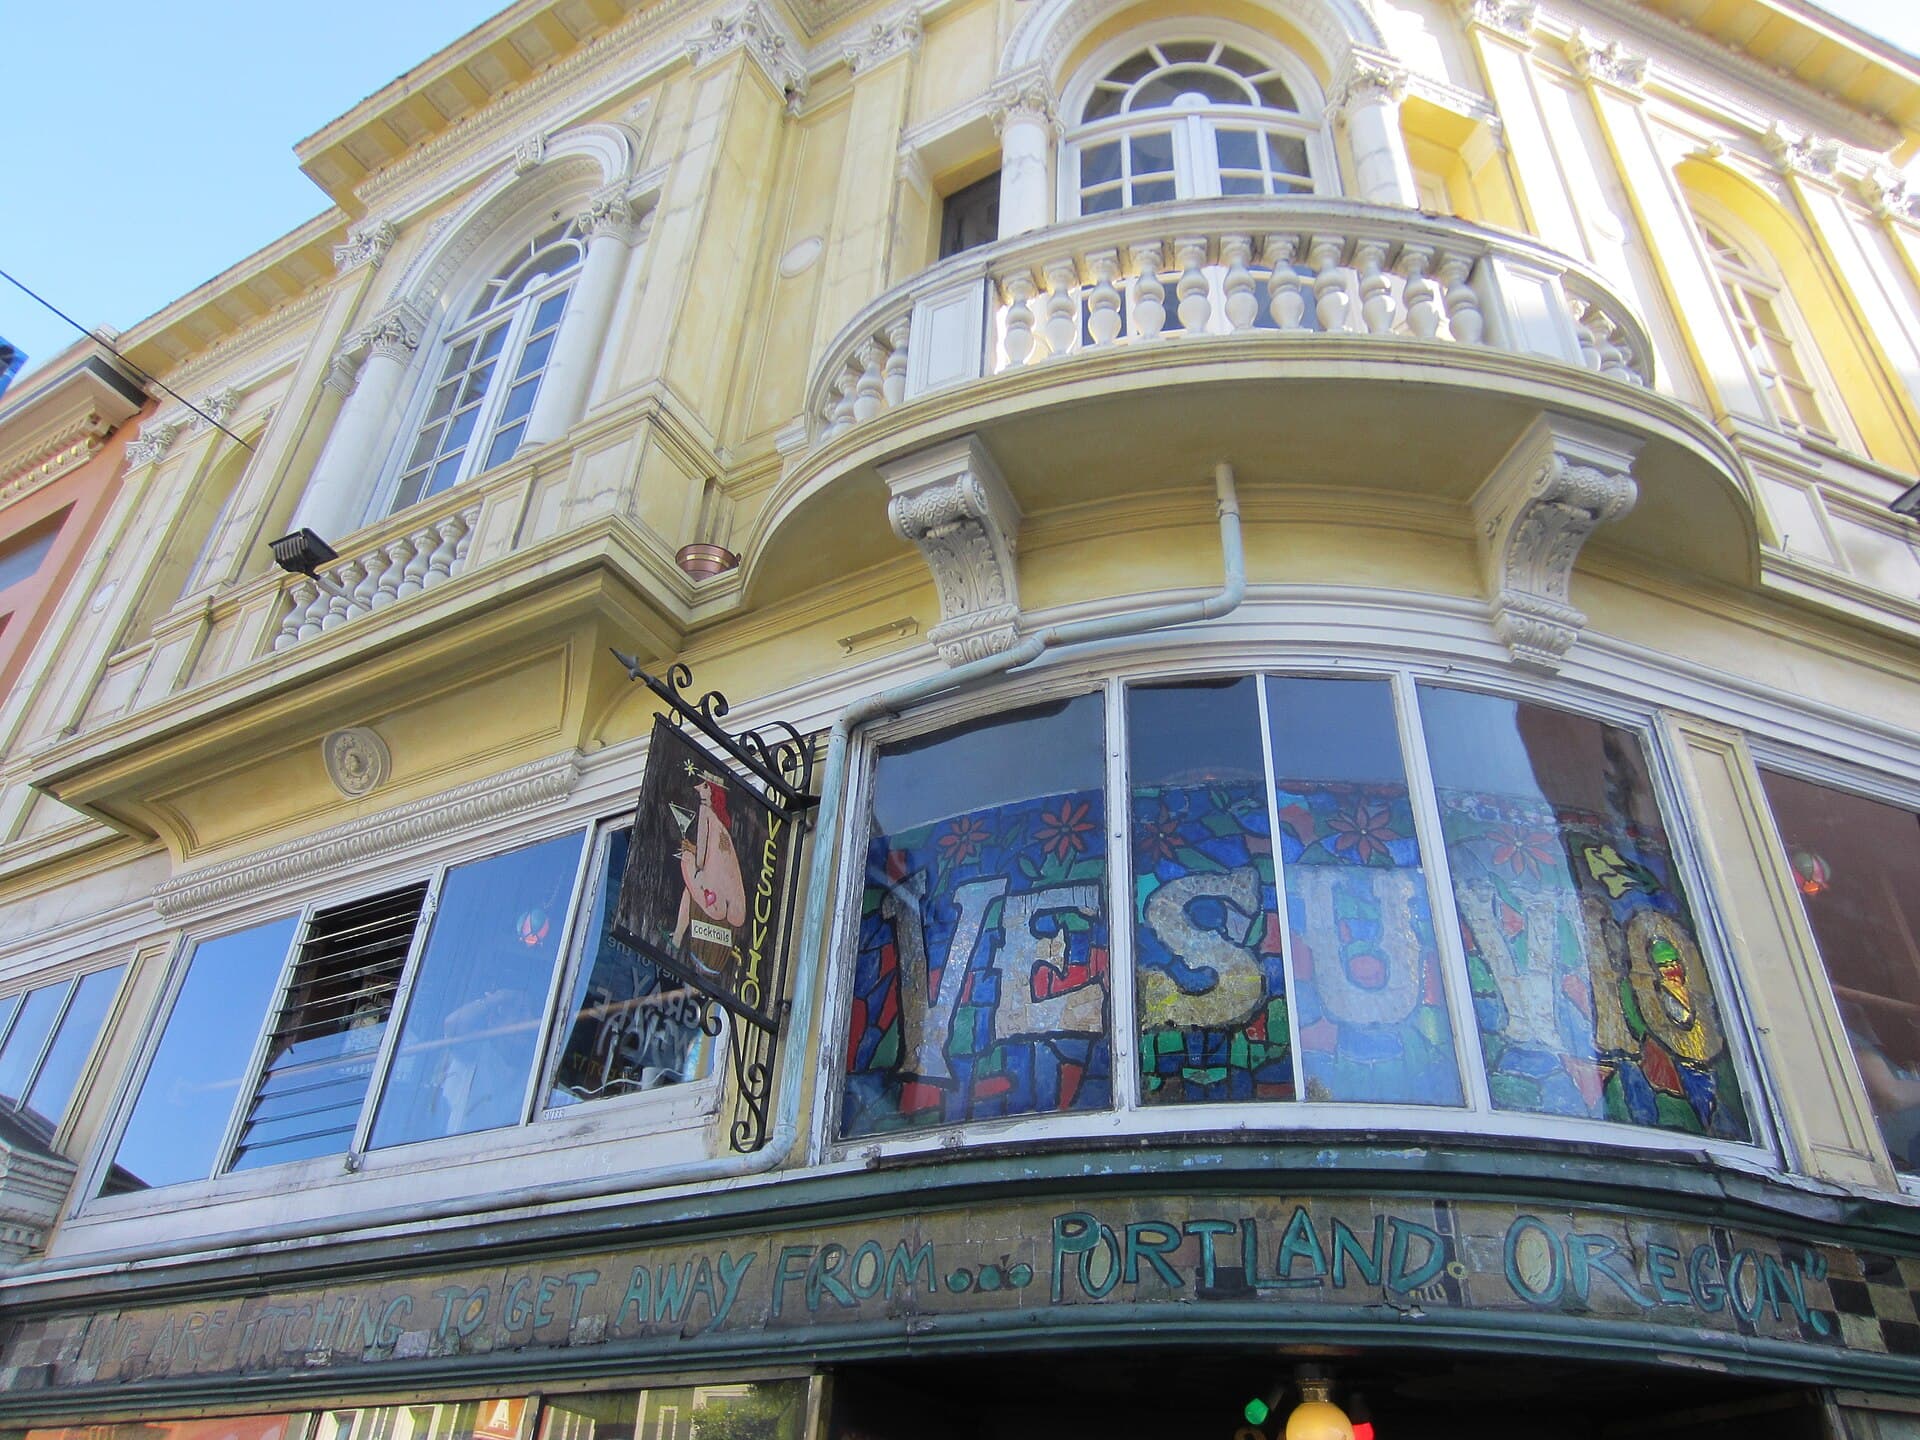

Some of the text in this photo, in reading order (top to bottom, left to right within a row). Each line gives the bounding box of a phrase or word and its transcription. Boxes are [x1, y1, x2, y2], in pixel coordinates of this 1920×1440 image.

[693, 924, 730, 943] cocktails
[741, 810, 782, 1009] VESUVIO
[882, 866, 1724, 1080] VESUVIO
[150, 1310, 227, 1363] ARE
[236, 1295, 413, 1358] ITCHING
[432, 1286, 491, 1340] TO
[503, 1269, 601, 1333] GET
[615, 1251, 758, 1333] AWAY
[1052, 1205, 1446, 1302] PORTLAND
